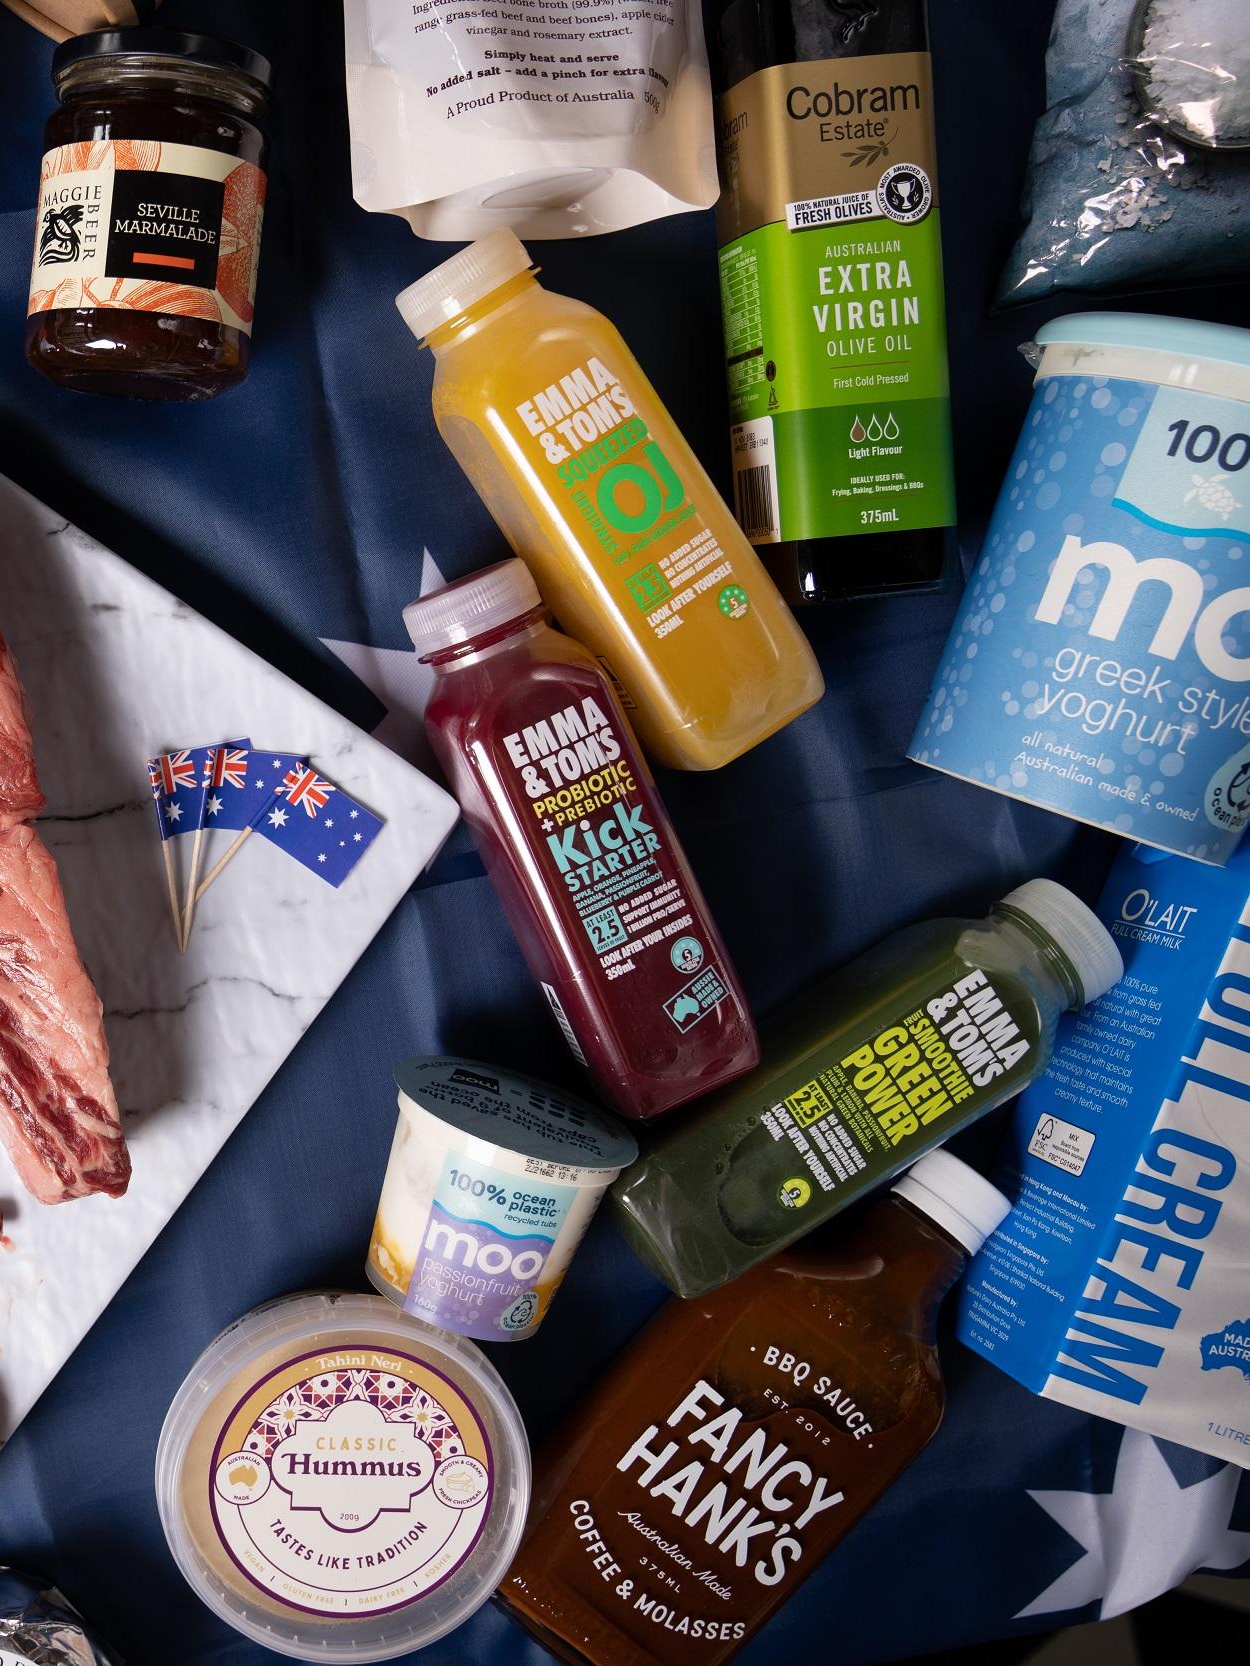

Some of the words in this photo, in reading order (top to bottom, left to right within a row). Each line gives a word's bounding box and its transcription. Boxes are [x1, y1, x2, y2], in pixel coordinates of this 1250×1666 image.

[485, 50, 526, 61] Simply
[530, 52, 554, 62] heat
[559, 54, 582, 63] and
[586, 53, 619, 62] serve
[447, 107, 454, 119] A
[456, 94, 495, 114] Proud
[499, 90, 551, 102] Product
[556, 93, 568, 102] of
[572, 90, 634, 102] Australia
[787, 83, 920, 120] Cobram
[820, 120, 885, 142] Estate
[43, 185, 101, 208] MAGGIE
[137, 203, 200, 223] SEVILLE
[795, 210, 831, 225] FRESH
[835, 202, 872, 218] OLIVES
[82, 203, 100, 261] BEER
[115, 220, 216, 244] MARMALADE
[825, 240, 901, 258] AUSTRALIAN
[818, 260, 912, 295] EXTRA
[812, 297, 920, 333] VIRGIN
[827, 338, 876, 357] OLIVE
[886, 335, 911, 350] OIL
[516, 357, 620, 437] EMMA
[834, 378, 852, 389] First
[855, 376, 874, 387] Cold
[876, 373, 909, 384] Pressed
[554, 385, 638, 452] TOM'S
[540, 432, 571, 465] &
[557, 418, 648, 489] SQUEEZED
[849, 447, 869, 459] Light
[872, 445, 902, 456] Flavour
[1167, 419, 1250, 472] 100
[596, 440, 684, 534] OJ
[861, 509, 899, 523] 375mL
[658, 558, 670, 569] NO
[670, 544, 691, 562] ADDED
[690, 528, 712, 548] SUGAR
[1052, 644, 1165, 704] greek
[1177, 683, 1250, 735] style
[503, 696, 609, 768] EMMA
[1035, 681, 1198, 758] yoghurt
[522, 766, 550, 798] &
[540, 727, 621, 788] TOM'S
[532, 760, 630, 818] PROBIOTIC
[1013, 749, 1094, 787] Australian
[1097, 776, 1137, 804] made
[1139, 792, 1151, 807] &
[1155, 800, 1198, 823] owned
[546, 802, 654, 874] Kick
[565, 833, 662, 892] STARTER
[1122, 888, 1197, 933] O'LAIT
[600, 951, 623, 968] LOOK
[621, 940, 645, 959] AFTER
[643, 929, 665, 948] YOUR
[662, 914, 693, 937] INSIDES
[1111, 923, 1130, 937] FULL
[1131, 929, 1161, 945] CREAM
[1161, 936, 1182, 951] MILK
[691, 971, 715, 995] AUSSIE
[927, 992, 958, 1023] &
[953, 969, 1030, 1070] EMMA
[1094, 1011, 1110, 1024] From
[1110, 1019, 1120, 1027] an
[1120, 1021, 1155, 1040] Australian
[909, 1019, 974, 1104] SMOOTHIE
[940, 1009, 1004, 1087] TOM'S
[840, 1044, 920, 1146] POWER
[873, 1026, 954, 1126] GREEN
[827, 1113, 839, 1126] NO
[834, 1125, 852, 1148] ADDED
[848, 1146, 867, 1170] SUGAR
[508, 1202, 557, 1218] plastic
[512, 1191, 556, 1207] ocean
[425, 1219, 543, 1280] moo
[1039, 1127, 1236, 1406] CREAM
[419, 1270, 485, 1306] yoghurt
[422, 1256, 522, 1296] passionfruit
[414, 1294, 438, 1313] 160g
[316, 1355, 367, 1371] Tahini
[370, 1355, 403, 1371] Neri
[763, 1346, 811, 1387] BBQ
[813, 1376, 873, 1441] SAUCE
[227, 1455, 261, 1467] AUSTRALIAN
[316, 1436, 396, 1451] CLASSIC
[667, 1379, 845, 1530] FANCY
[281, 1453, 421, 1478] Hummus
[616, 1424, 802, 1587] HANK'S
[269, 1518, 313, 1561] TASTES
[318, 1554, 350, 1570] LIKE
[356, 1521, 428, 1569] TRADITION
[569, 1499, 622, 1582] COFFEE
[615, 1579, 634, 1600] &
[633, 1593, 746, 1641] MOLASSES
[282, 1582, 312, 1601] GLUTEN
[315, 1592, 335, 1604] FREE
